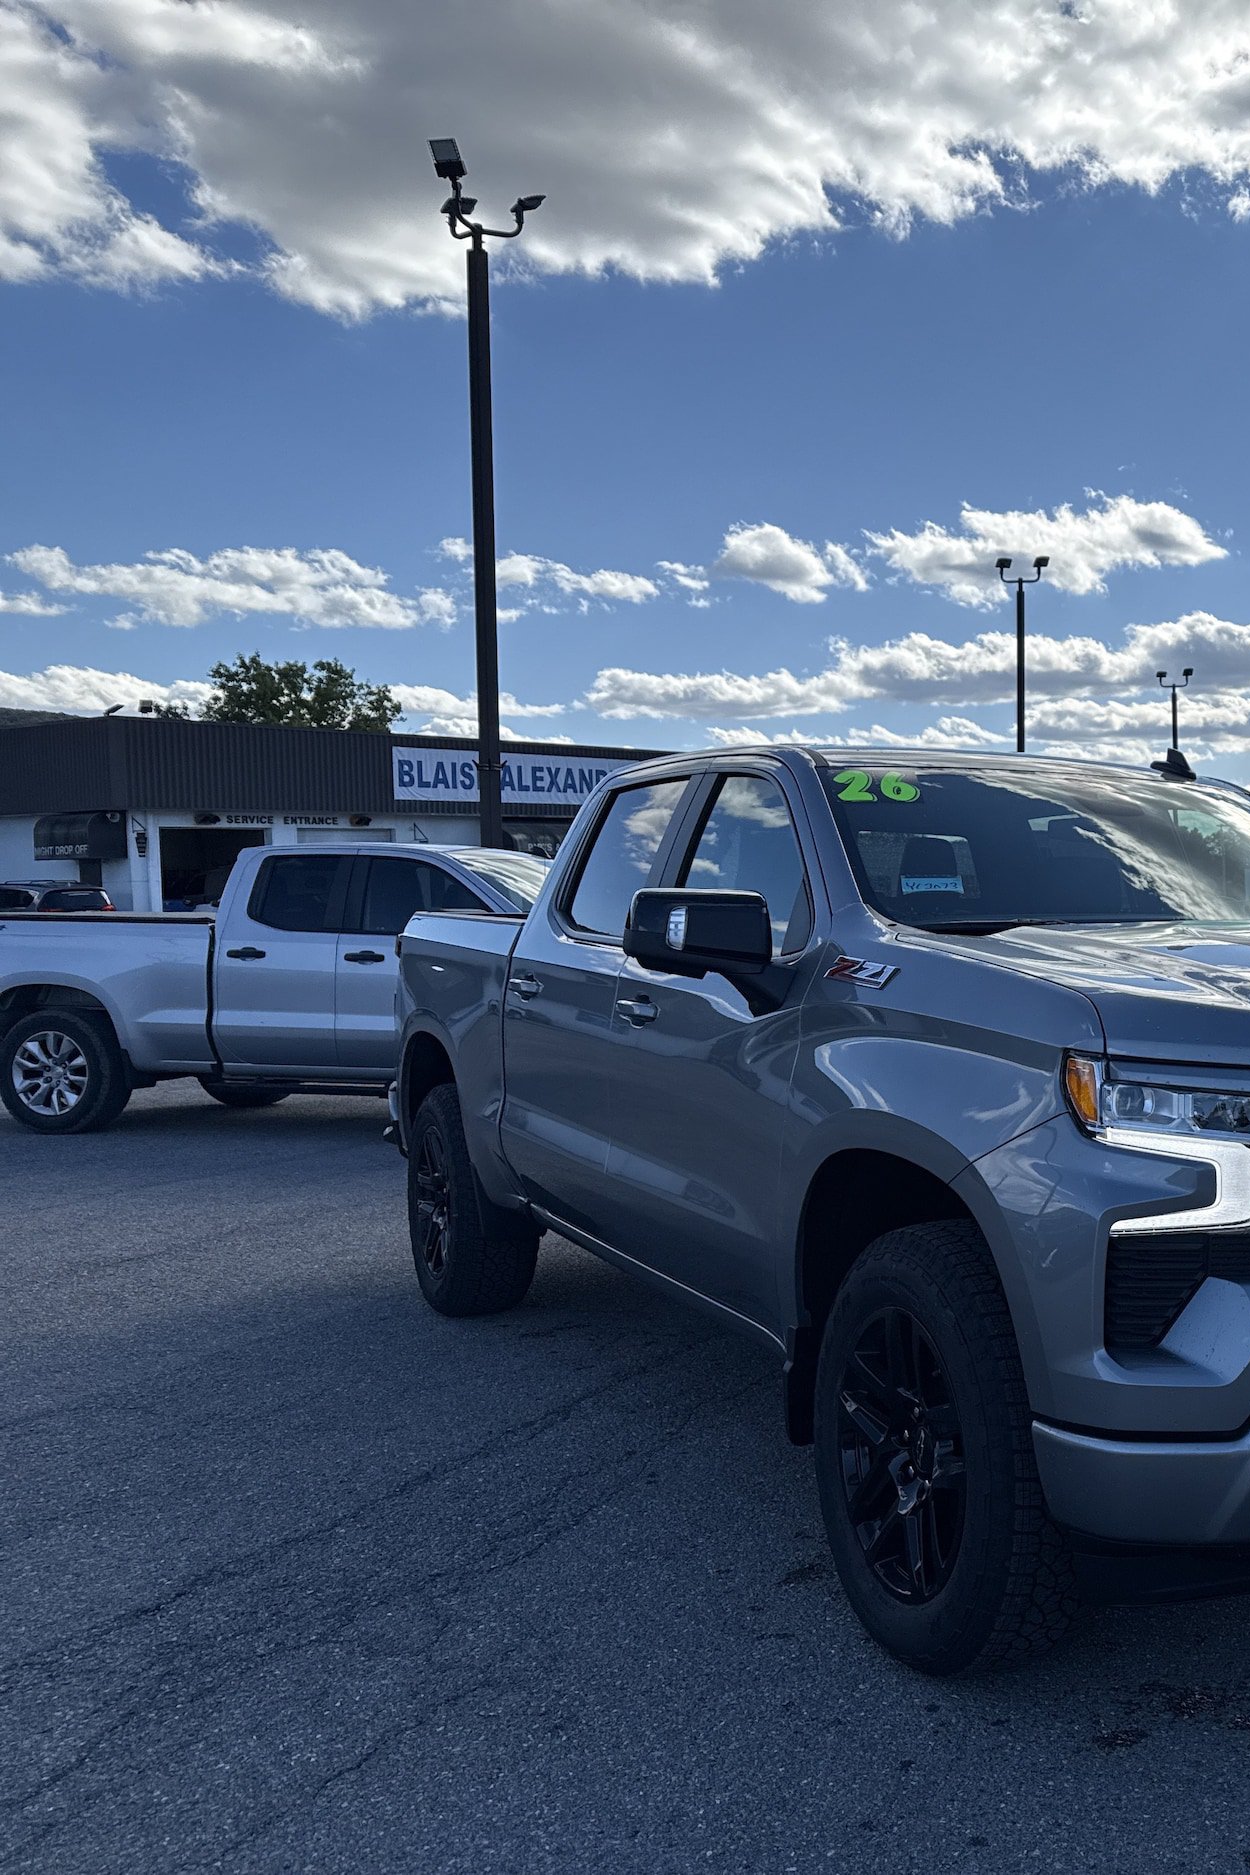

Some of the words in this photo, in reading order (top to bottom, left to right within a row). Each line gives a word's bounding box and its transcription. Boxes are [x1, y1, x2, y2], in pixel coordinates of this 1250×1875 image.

[398, 759, 480, 788] BLAIS
[501, 764, 613, 793] ALEXAND
[833, 770, 920, 802] 26
[226, 815, 274, 824] SERVICE
[283, 816, 339, 825] ENTRANCE
[55, 845, 73, 855] DROP
[75, 844, 88, 854] OFF
[823, 955, 902, 990] Z71
